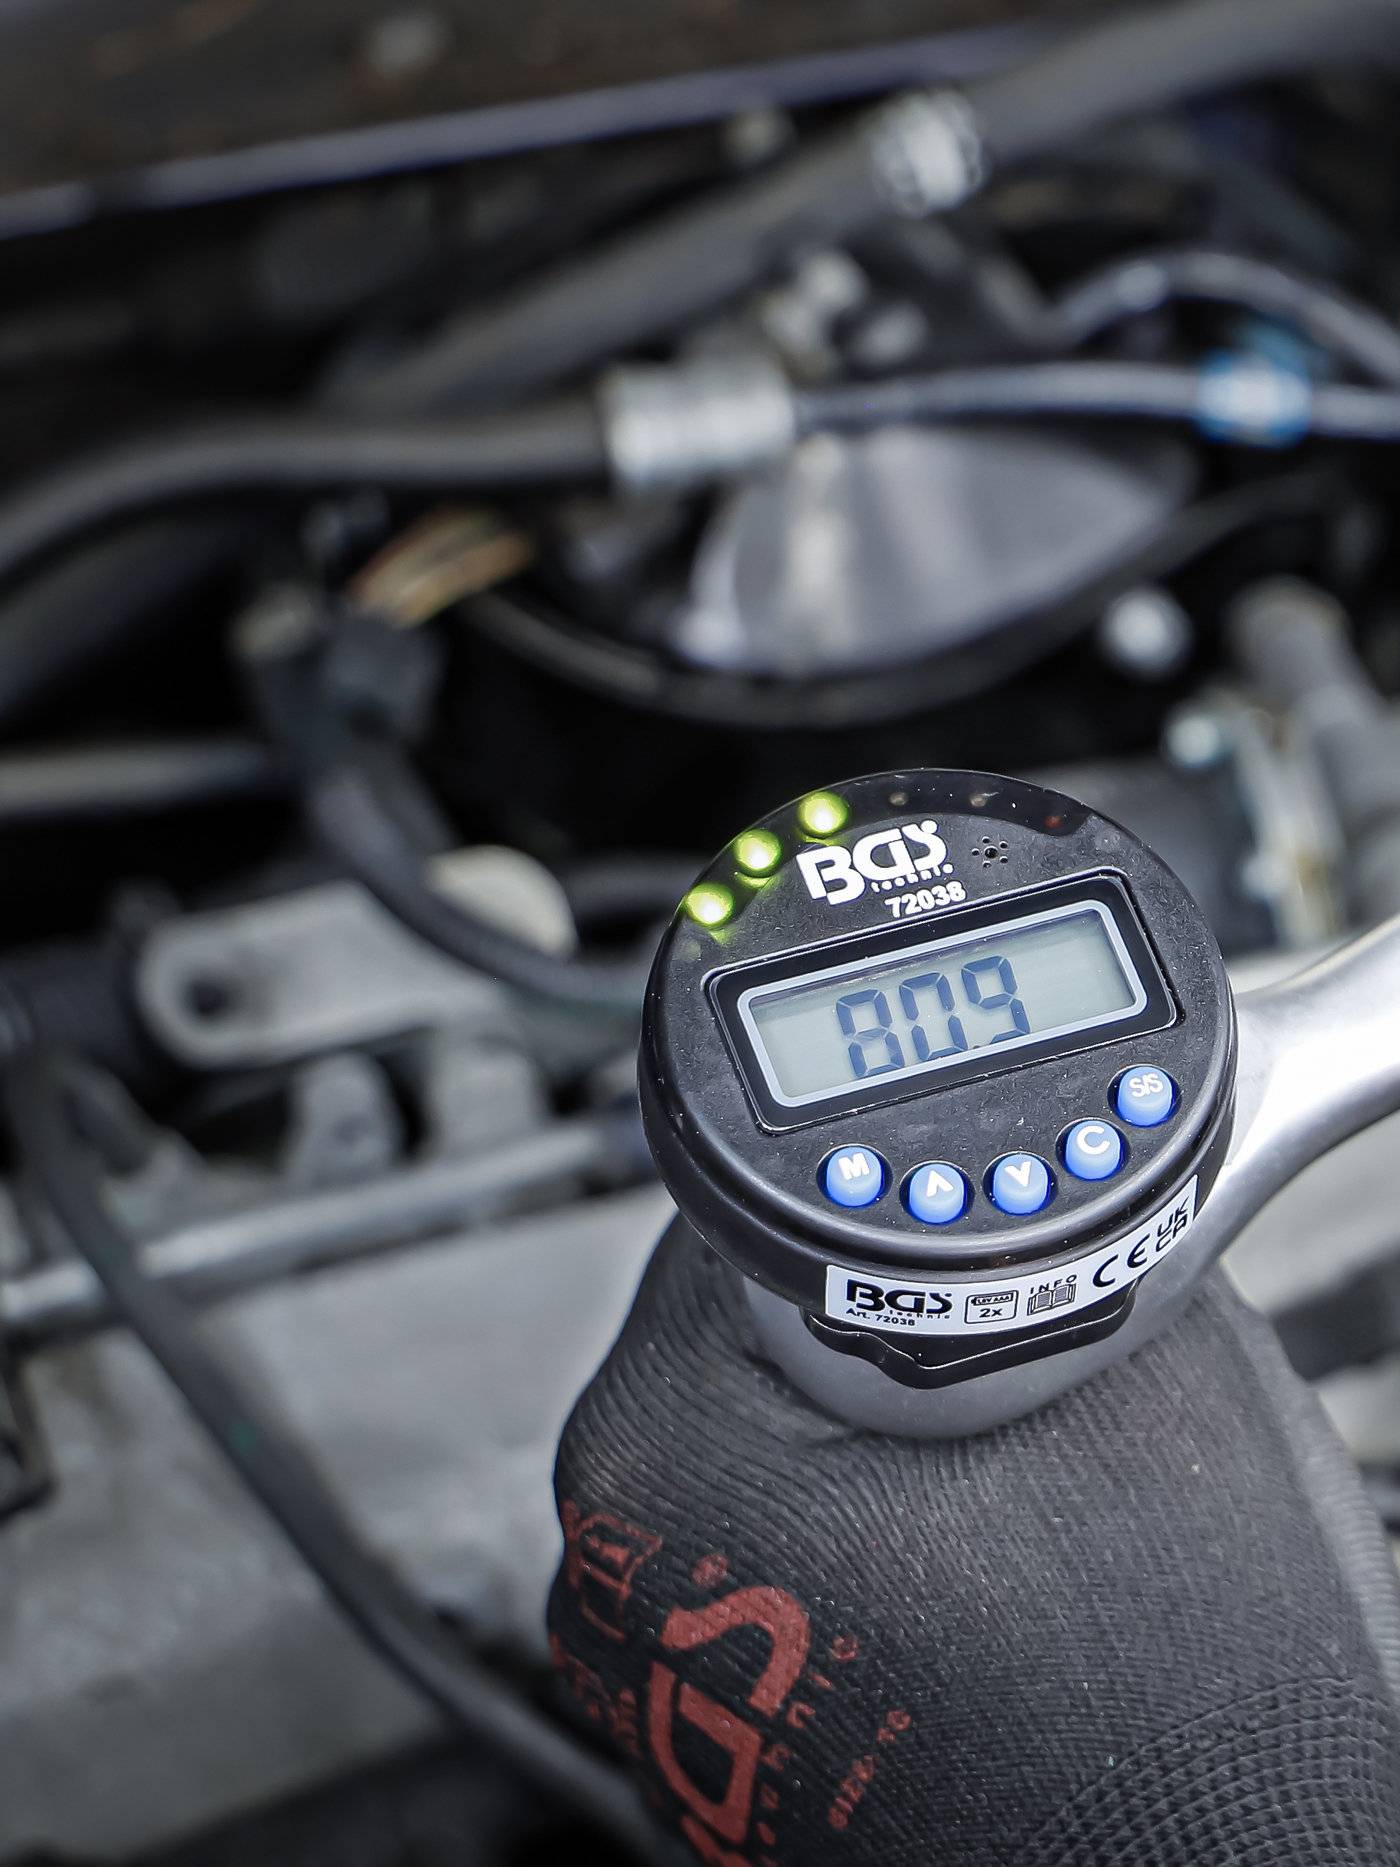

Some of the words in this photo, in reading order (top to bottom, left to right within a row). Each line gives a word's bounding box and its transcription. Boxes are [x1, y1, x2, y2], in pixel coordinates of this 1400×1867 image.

[796, 818, 948, 906] BGS
[884, 880, 967, 919] 72038
[1076, 1125, 1111, 1155] C
[837, 1152, 870, 1180] M
[846, 1278, 953, 1315] BGS
[1030, 1274, 1077, 1295] INFO
[845, 1307, 871, 1320] Art.
[875, 1313, 916, 1327] 72038
